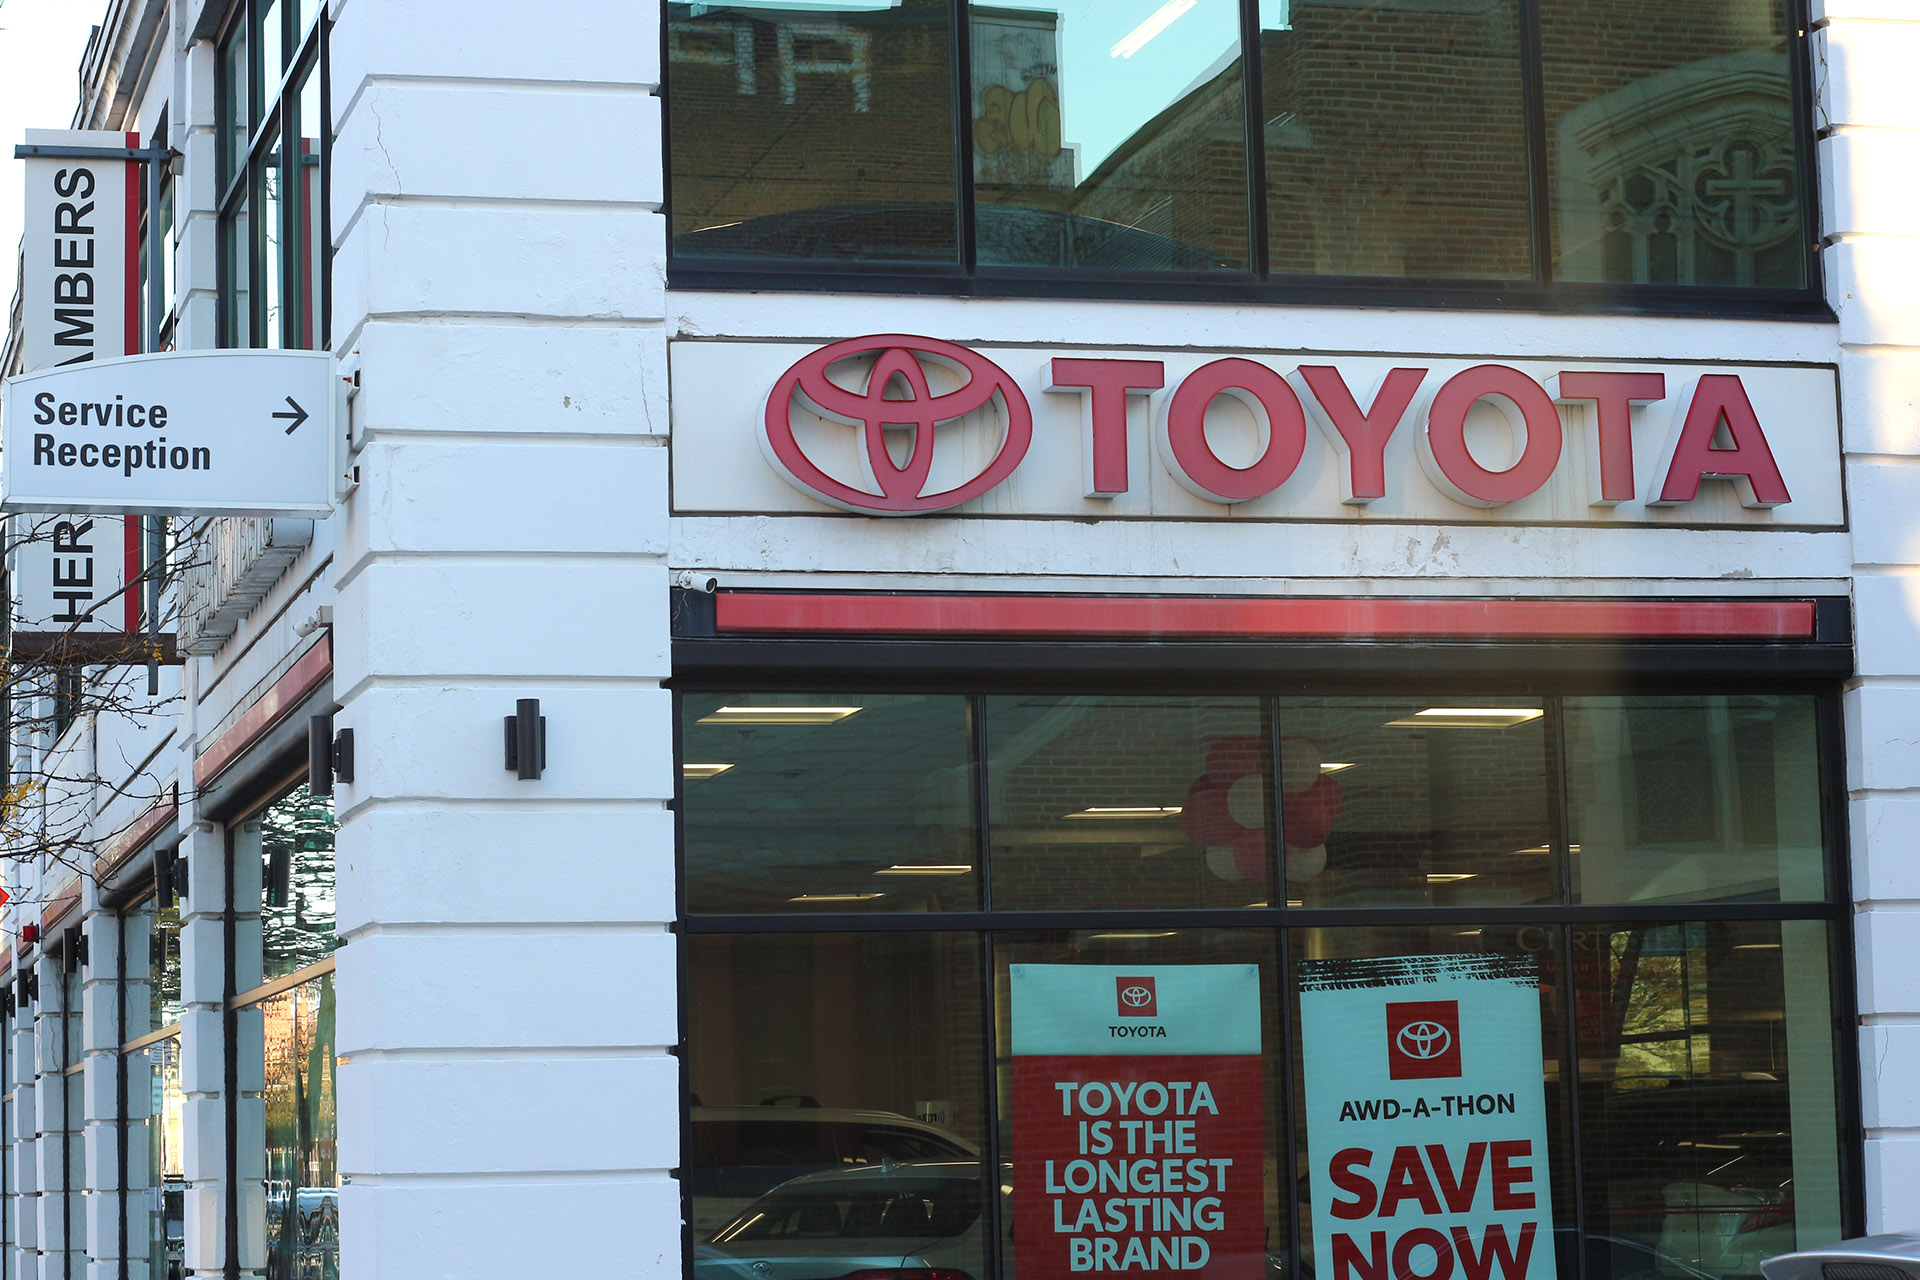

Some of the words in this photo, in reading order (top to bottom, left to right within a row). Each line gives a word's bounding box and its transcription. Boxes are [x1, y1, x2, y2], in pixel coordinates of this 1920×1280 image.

[34, 392, 168, 428] Service
[1050, 356, 1792, 506] TOYOTA
[34, 433, 210, 477] Reception
[1109, 1026, 1167, 1038] TOYOTA
[1055, 1081, 1219, 1116] TOYOTA
[1339, 1093, 1516, 1122] AWD-A-THON
[1079, 1121, 1113, 1155] IS
[1119, 1120, 1197, 1154] THE
[1045, 1158, 1233, 1194] LONGEST
[1329, 1139, 1536, 1220] SAVE
[1053, 1196, 1225, 1233] LASTING
[1070, 1236, 1211, 1272] BRAND
[1331, 1222, 1538, 1280] NOW
